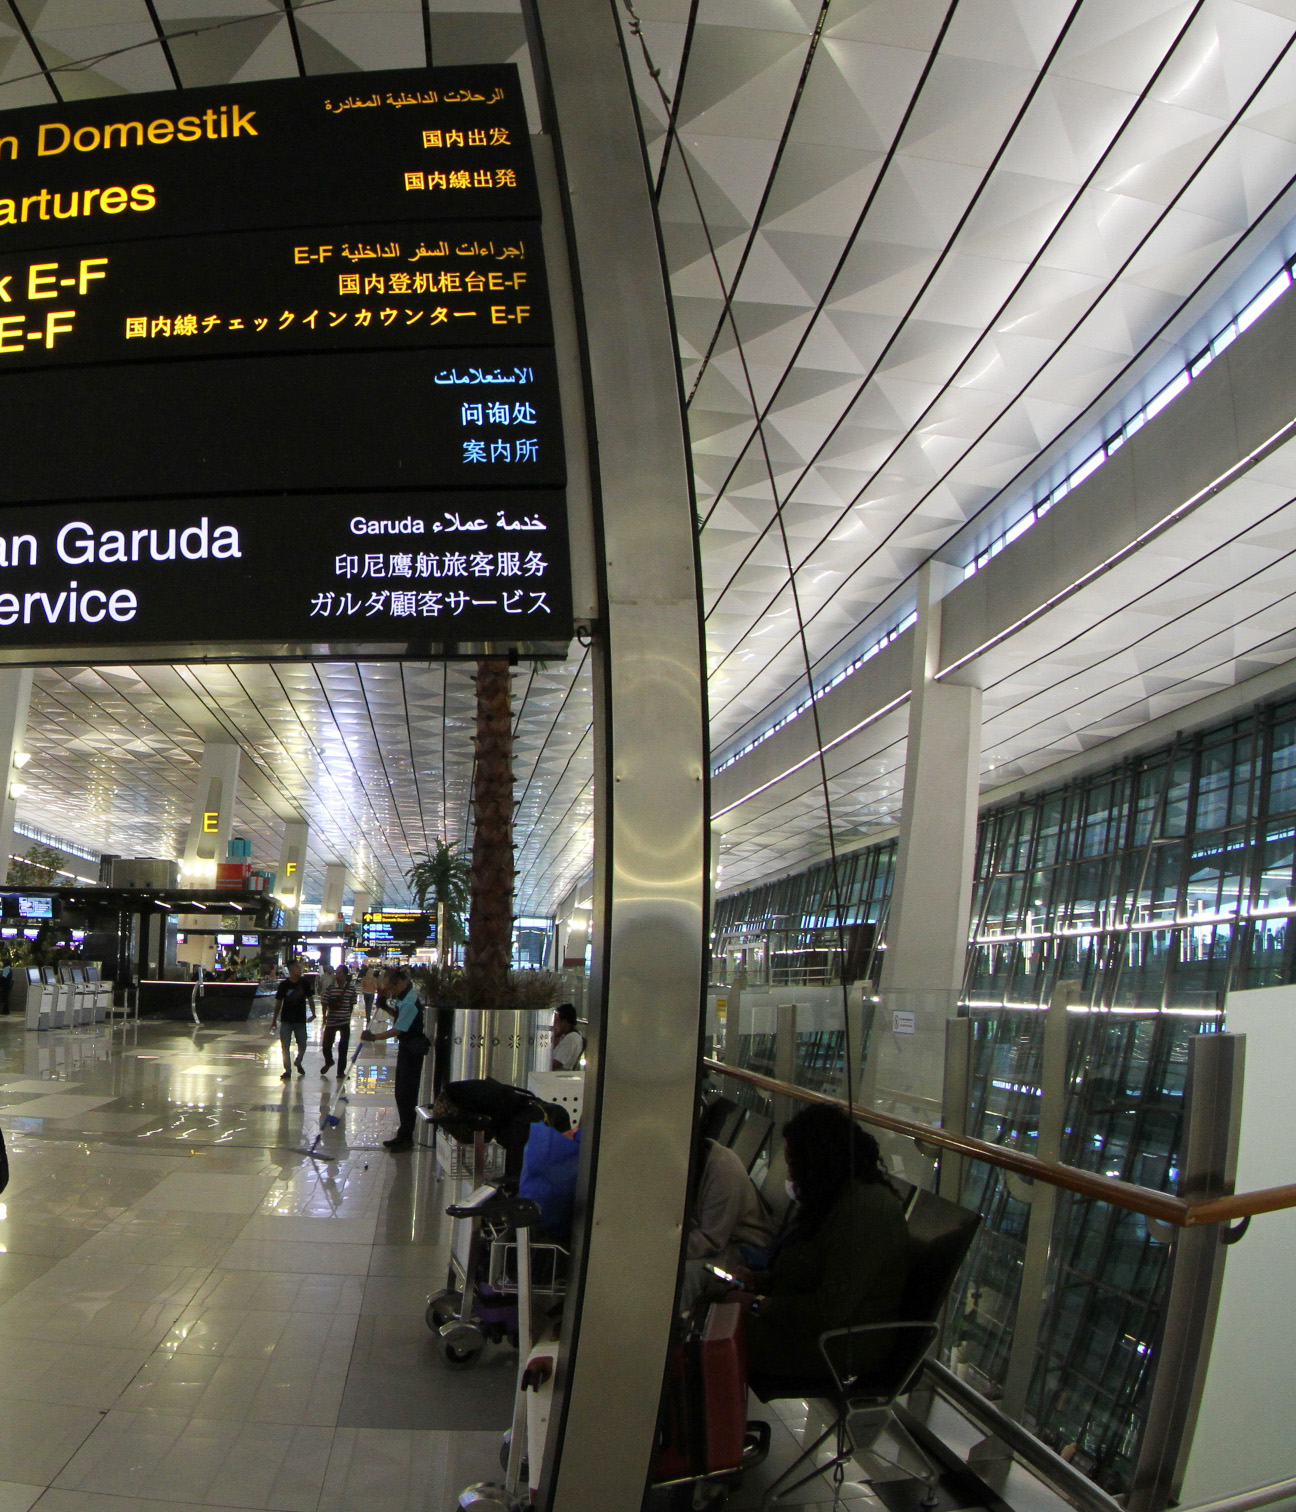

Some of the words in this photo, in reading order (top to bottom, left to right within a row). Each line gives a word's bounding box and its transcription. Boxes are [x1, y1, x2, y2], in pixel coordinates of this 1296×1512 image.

[324, 94, 382, 114] المغادرة
[386, 91, 438, 109] الداخلية
[443, 87, 505, 105] الرحلات
[37, 106, 259, 157] Domestik
[422, 127, 511, 149] 国内出发
[403, 168, 517, 192] 国内線出発
[293, 245, 334, 265] E-F
[340, 242, 401, 263] الداخلية
[408, 241, 450, 262] السفر
[27, 257, 109, 300] E-F
[125, 305, 477, 340] 国内線チェックインカウンター
[490, 305, 531, 325] E-F
[434, 367, 535, 385] الاستعلامات
[461, 401, 538, 426] 问询处
[462, 438, 540, 464] 案内所
[349, 516, 425, 536] Garuda
[432, 512, 489, 534] عملاء
[495, 510, 548, 531] خدمة
[55, 516, 243, 566] Garuda
[335, 550, 550, 580] 印尼鹰航旅客服务
[309, 589, 552, 618] ガルダ顧客サービス
[203, 812, 219, 833] E
[286, 862, 298, 877] F
